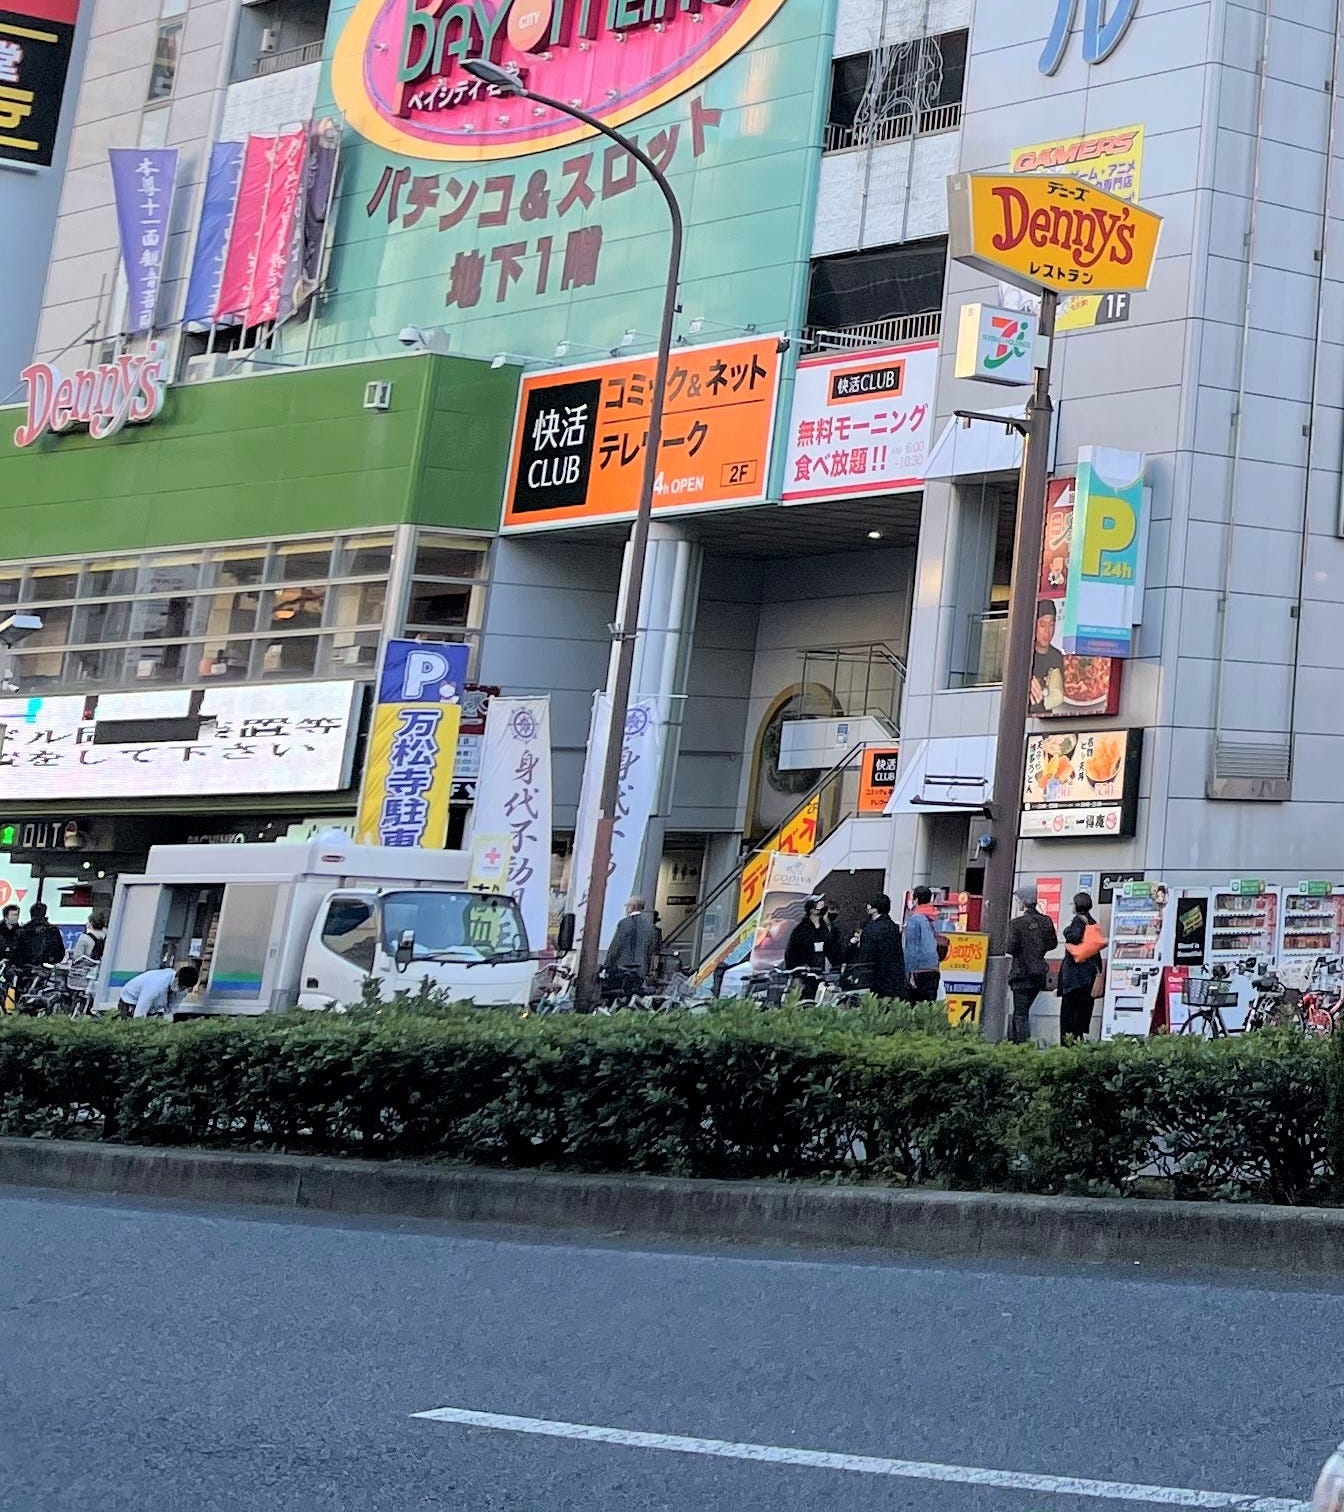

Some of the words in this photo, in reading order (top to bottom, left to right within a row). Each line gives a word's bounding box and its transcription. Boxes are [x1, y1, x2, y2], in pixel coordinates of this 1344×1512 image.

[408, 80, 501, 110] ベイシティ
[1013, 131, 1140, 173] GAMERS
[992, 186, 1136, 268] Denny's
[445, 225, 602, 308] 地下1階
[1029, 261, 1094, 285] レストラン
[1106, 294, 1128, 319] 1F
[14, 342, 162, 447] Denny's
[532, 404, 588, 451] 快活
[797, 403, 928, 447] 無料モーニング
[528, 455, 580, 489] CLUB
[671, 476, 704, 494] OPEN
[729, 464, 749, 484] 2F
[1082, 495, 1136, 576] P
[402, 651, 448, 699] P
